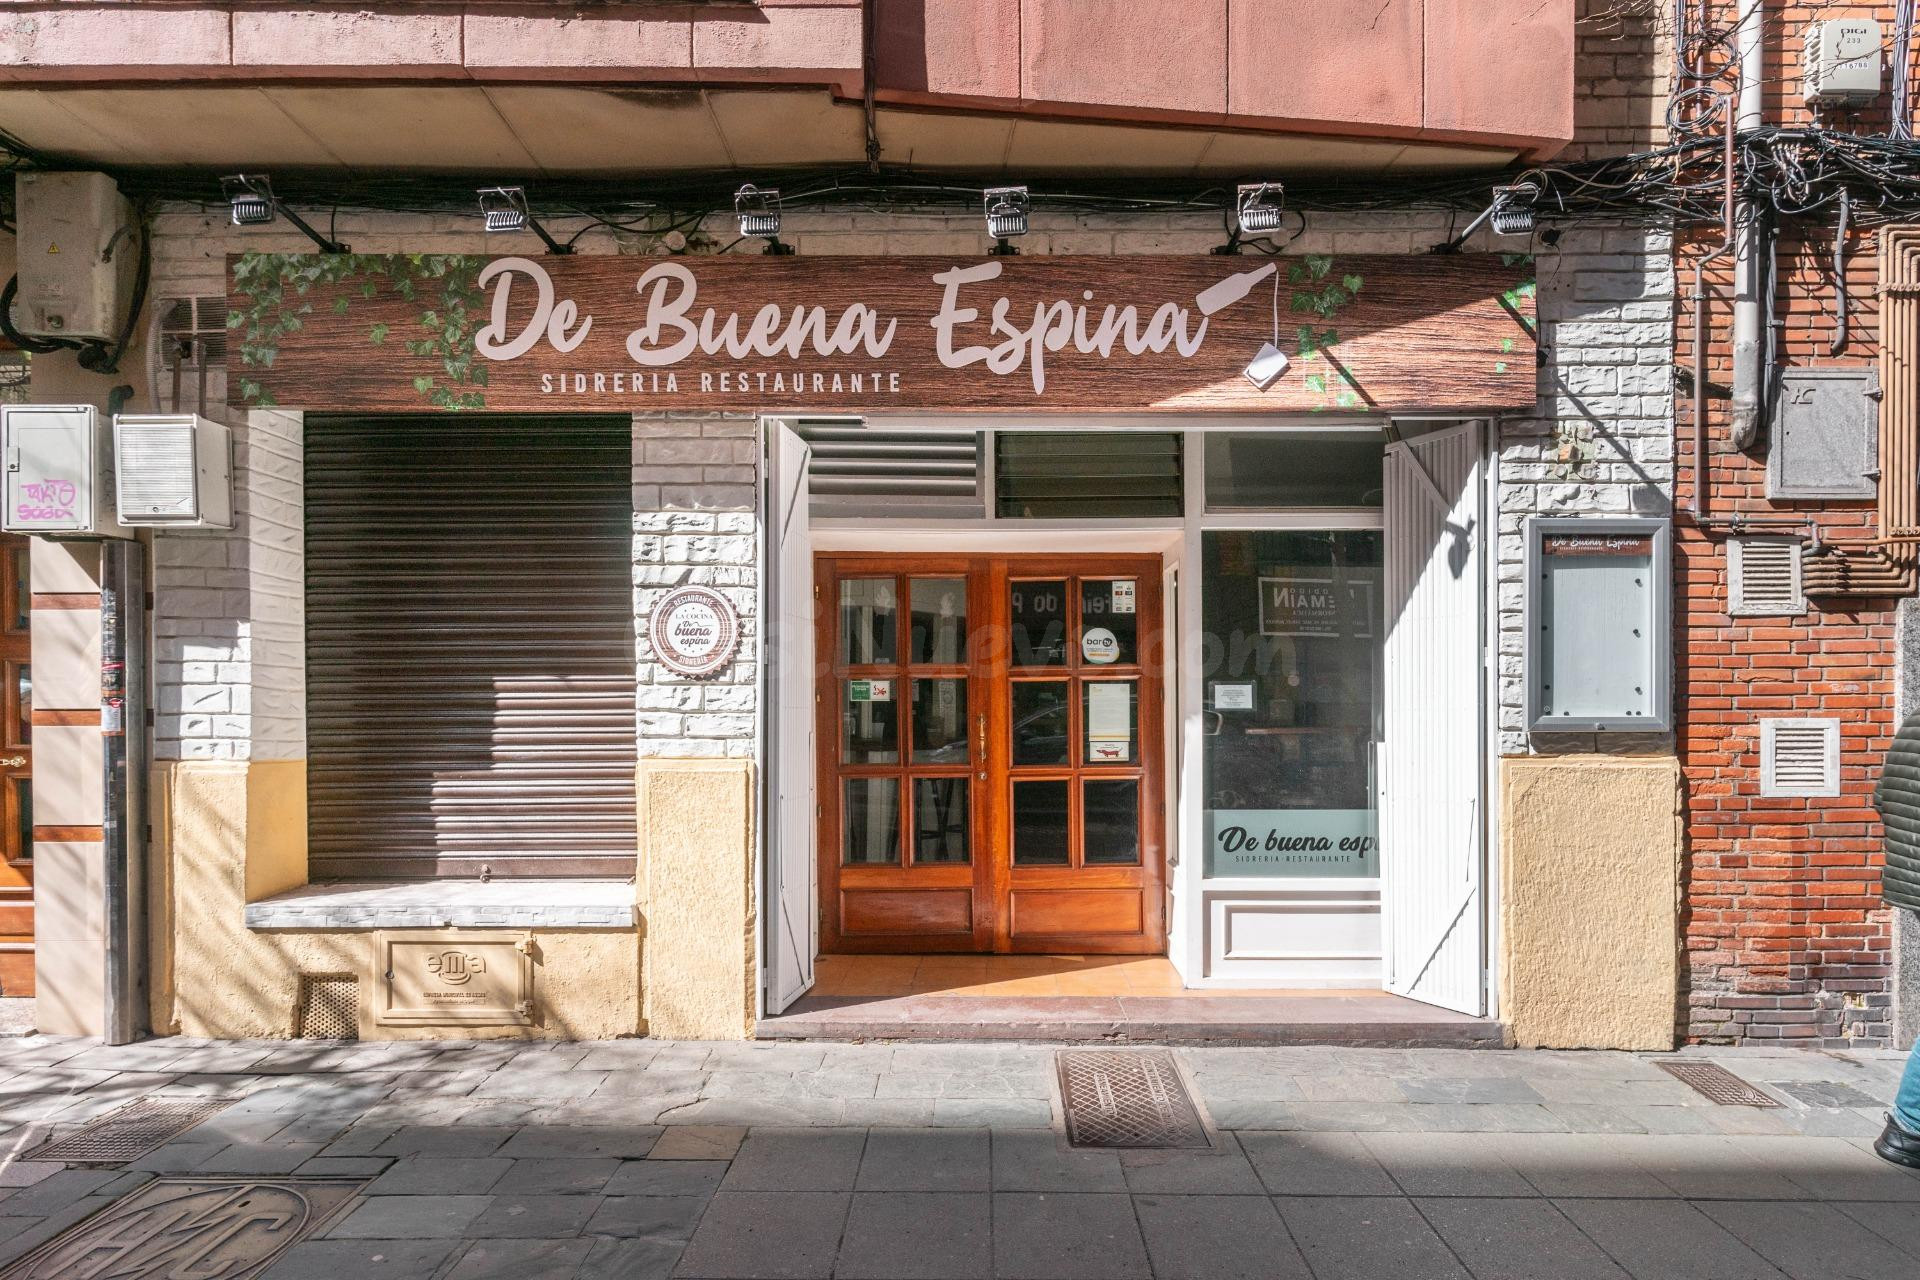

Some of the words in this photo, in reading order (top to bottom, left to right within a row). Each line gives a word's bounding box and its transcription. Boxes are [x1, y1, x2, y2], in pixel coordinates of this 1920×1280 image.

[475, 257, 592, 361] De
[626, 262, 897, 366] Buena
[930, 261, 1209, 396] Espina
[541, 372, 679, 393] SIDRERIA
[701, 372, 901, 393] RESTAURANTE
[673, 594, 714, 607] RESTAURANTE
[674, 623, 713, 636] buena
[680, 636, 711, 648] espina
[1217, 825, 1260, 853] De
[1264, 828, 1334, 852] buena
[1235, 855, 1280, 863] SIDRERIA
[1286, 855, 1352, 863] RESTAURANTE
